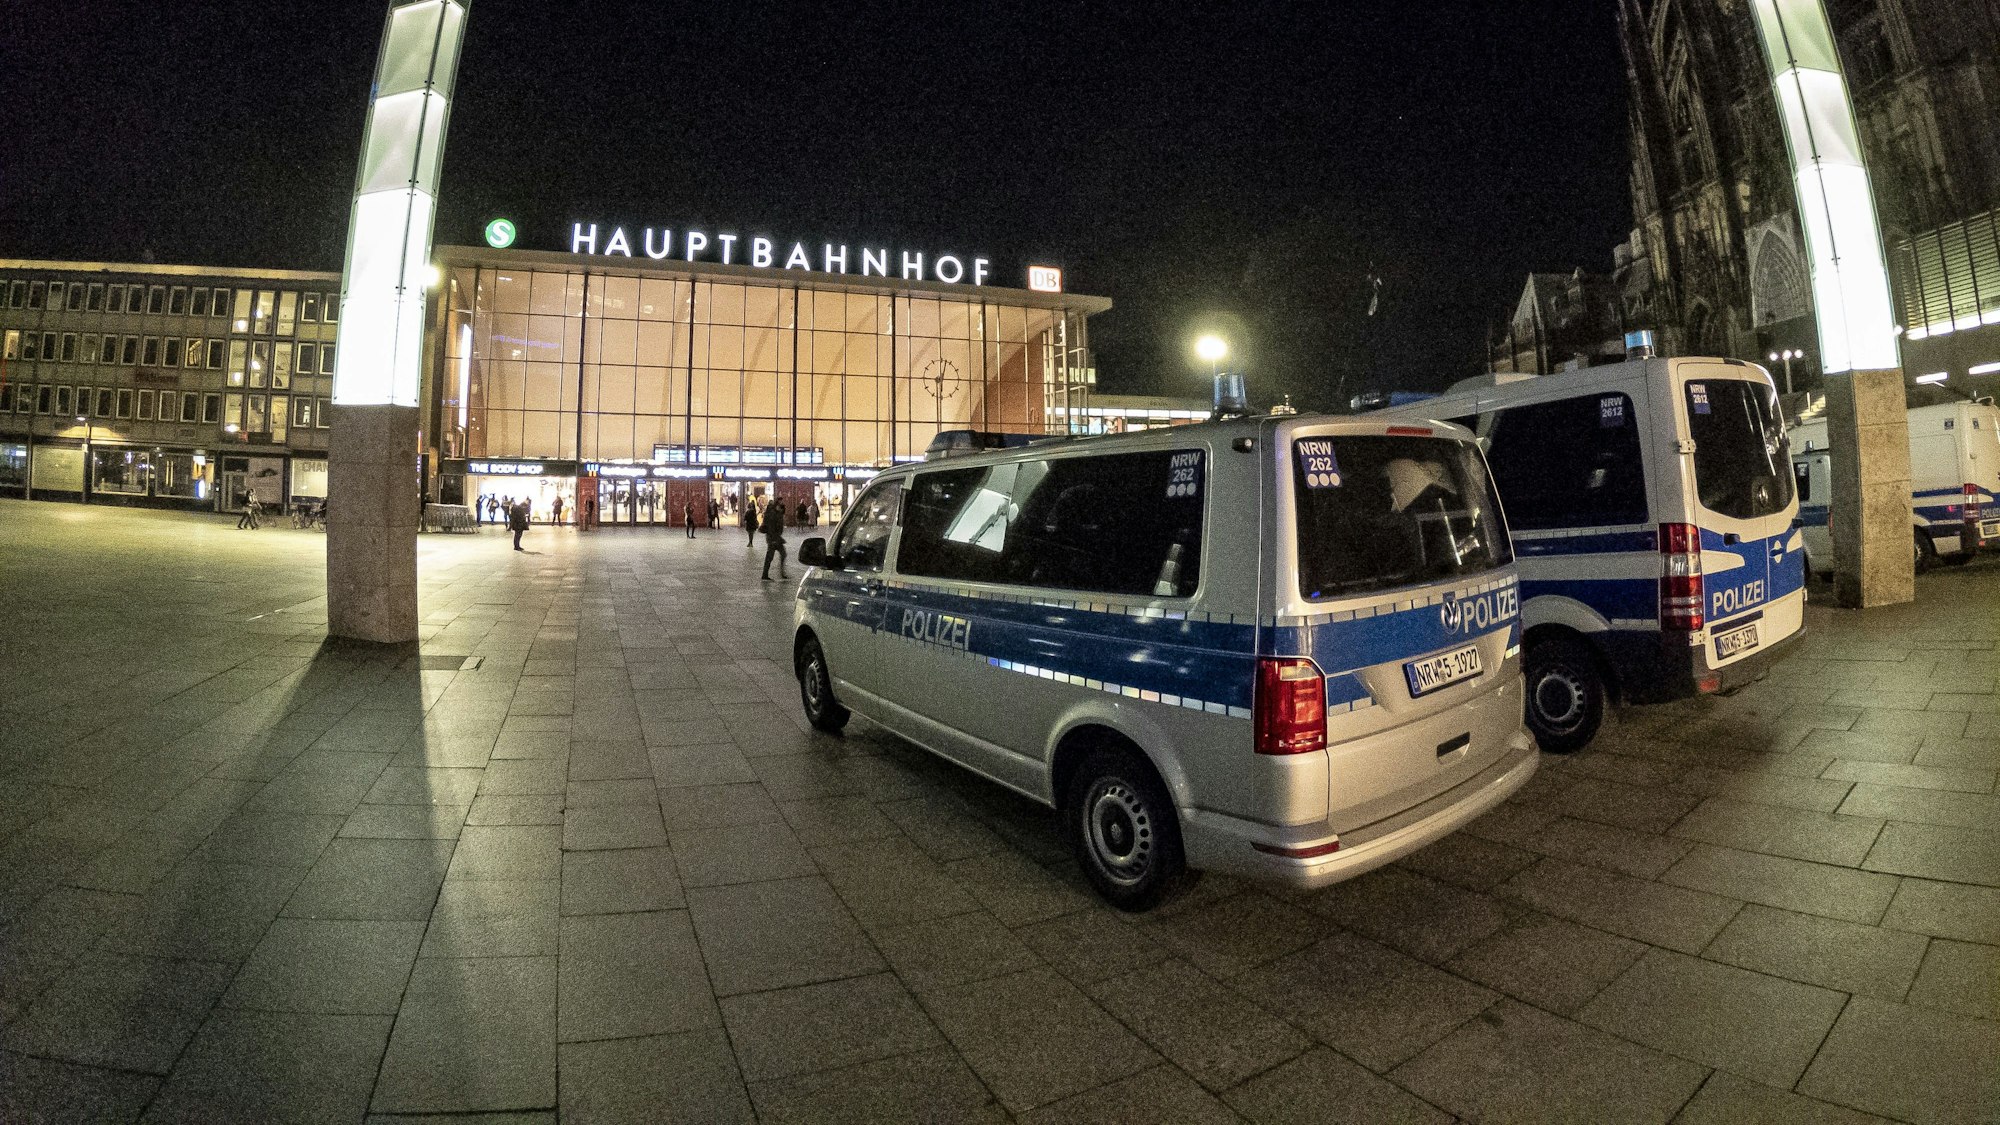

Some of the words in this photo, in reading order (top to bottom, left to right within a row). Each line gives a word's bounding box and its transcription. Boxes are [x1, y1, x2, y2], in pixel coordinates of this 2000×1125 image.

[571, 222, 989, 286] HAUPTBAHNHOF
[1033, 269, 1057, 288] DB
[1600, 397, 1623, 408] NRW
[1602, 407, 1622, 418] 2612
[1300, 442, 1332, 456] NRW
[1171, 452, 1200, 468] NRW
[1308, 457, 1332, 471] 262
[470, 463, 489, 473] THE
[490, 464, 517, 474] BODY
[518, 465, 543, 475] SHOP
[1173, 468, 1194, 482] 262
[1712, 579, 1765, 616] POLIZEI
[1463, 587, 1518, 633] POLIZEI
[901, 608, 972, 651] POLIZEI
[1416, 660, 1440, 687] NRW
[1443, 648, 1478, 677] 5-1927
